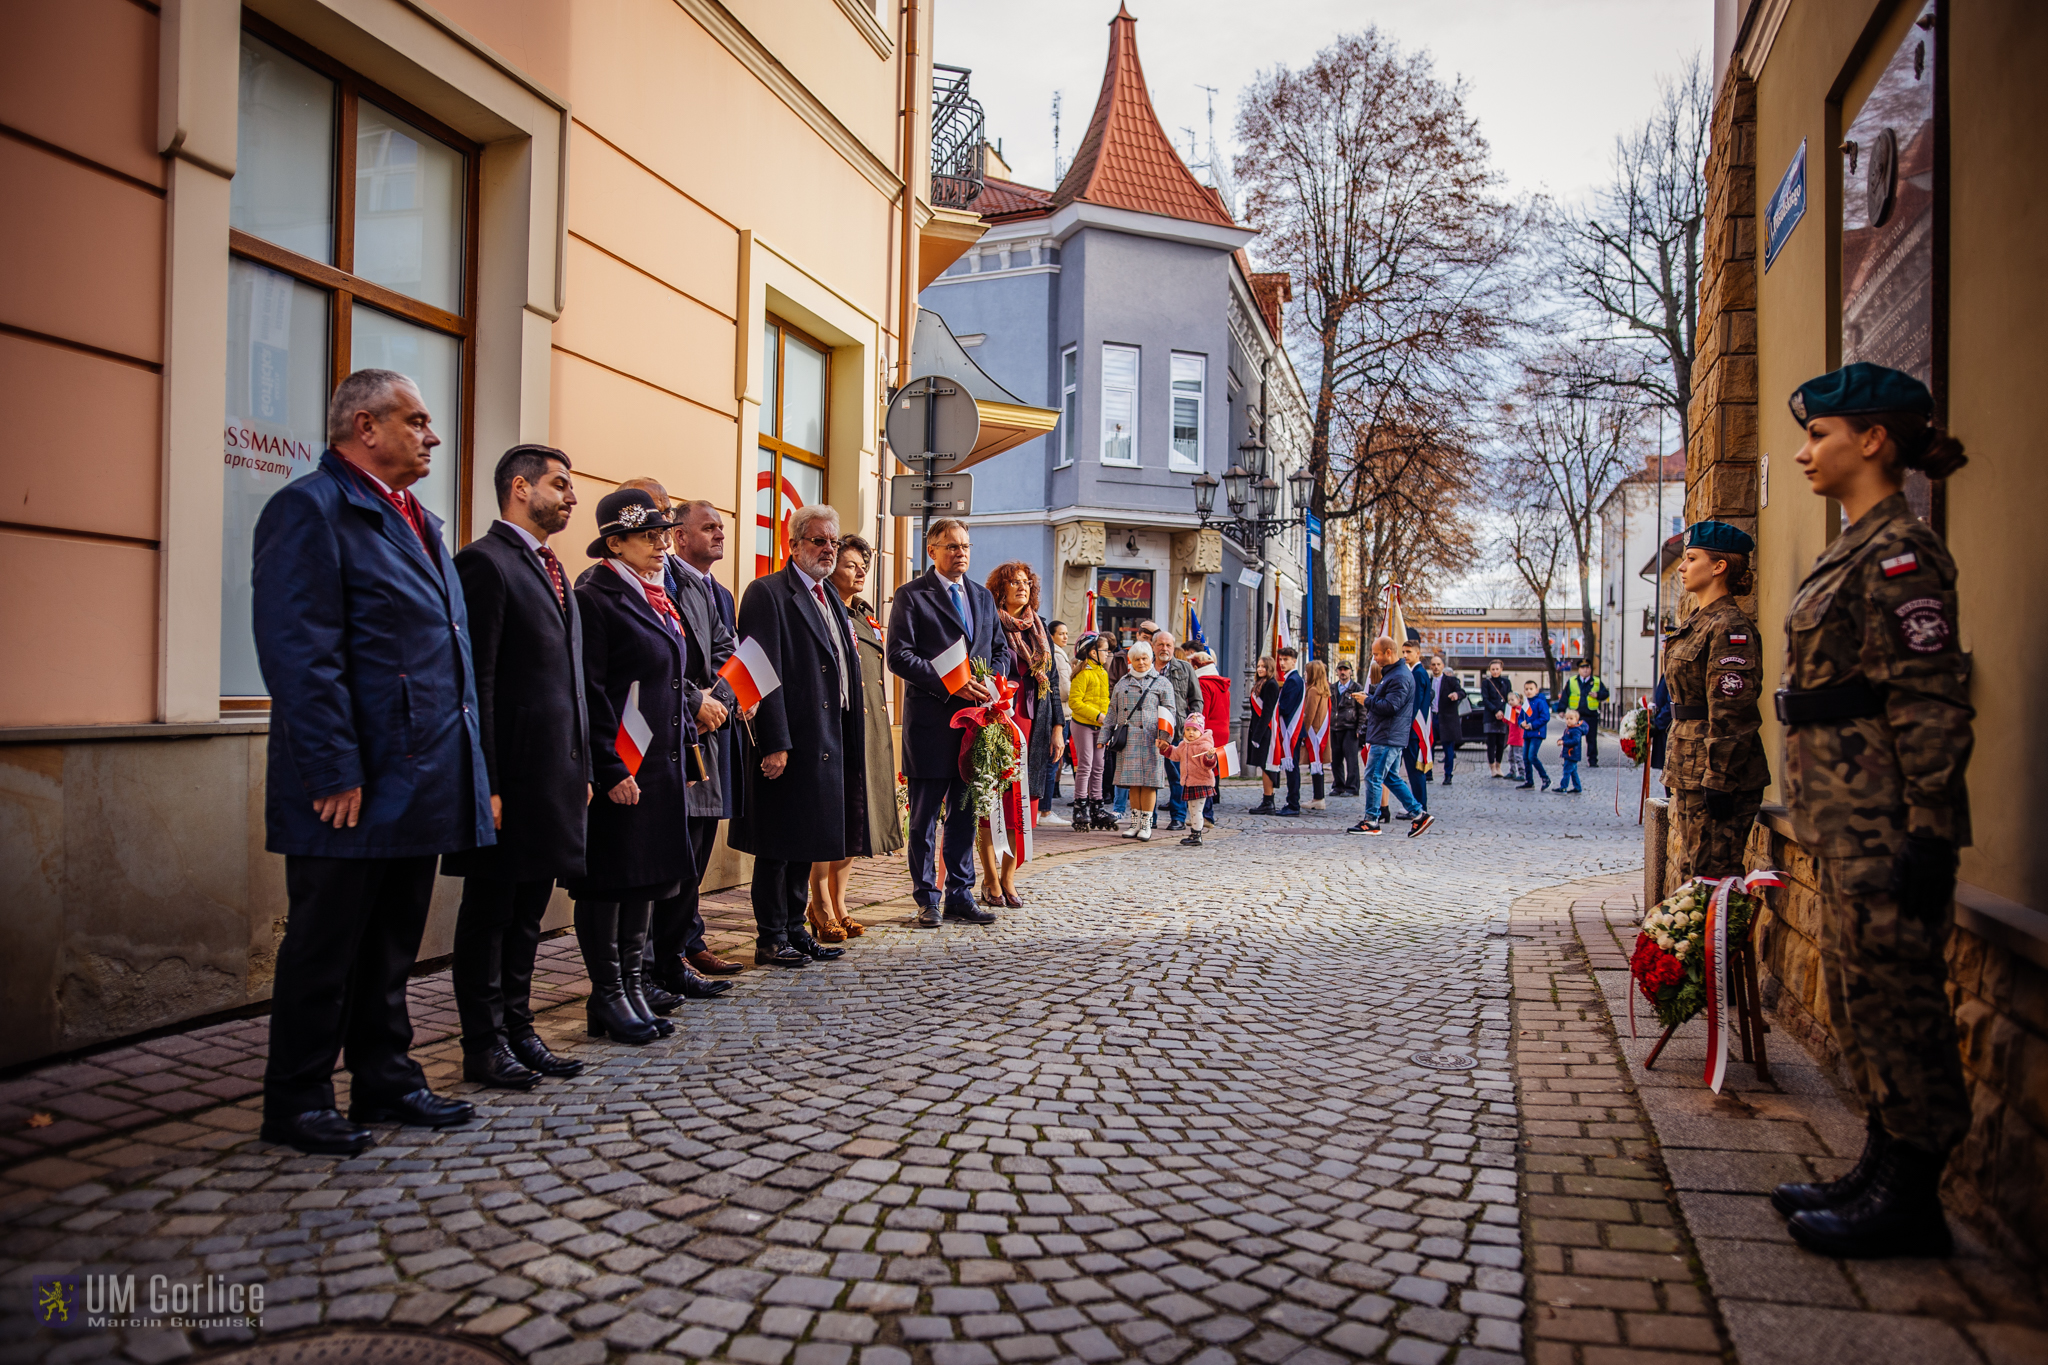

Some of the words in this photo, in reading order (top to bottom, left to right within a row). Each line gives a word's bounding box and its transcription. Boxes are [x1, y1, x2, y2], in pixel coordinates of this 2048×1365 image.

[224, 426, 311, 463] SSMANN
[224, 451, 294, 479] apraszamy
[1122, 600, 1148, 608] SALON
